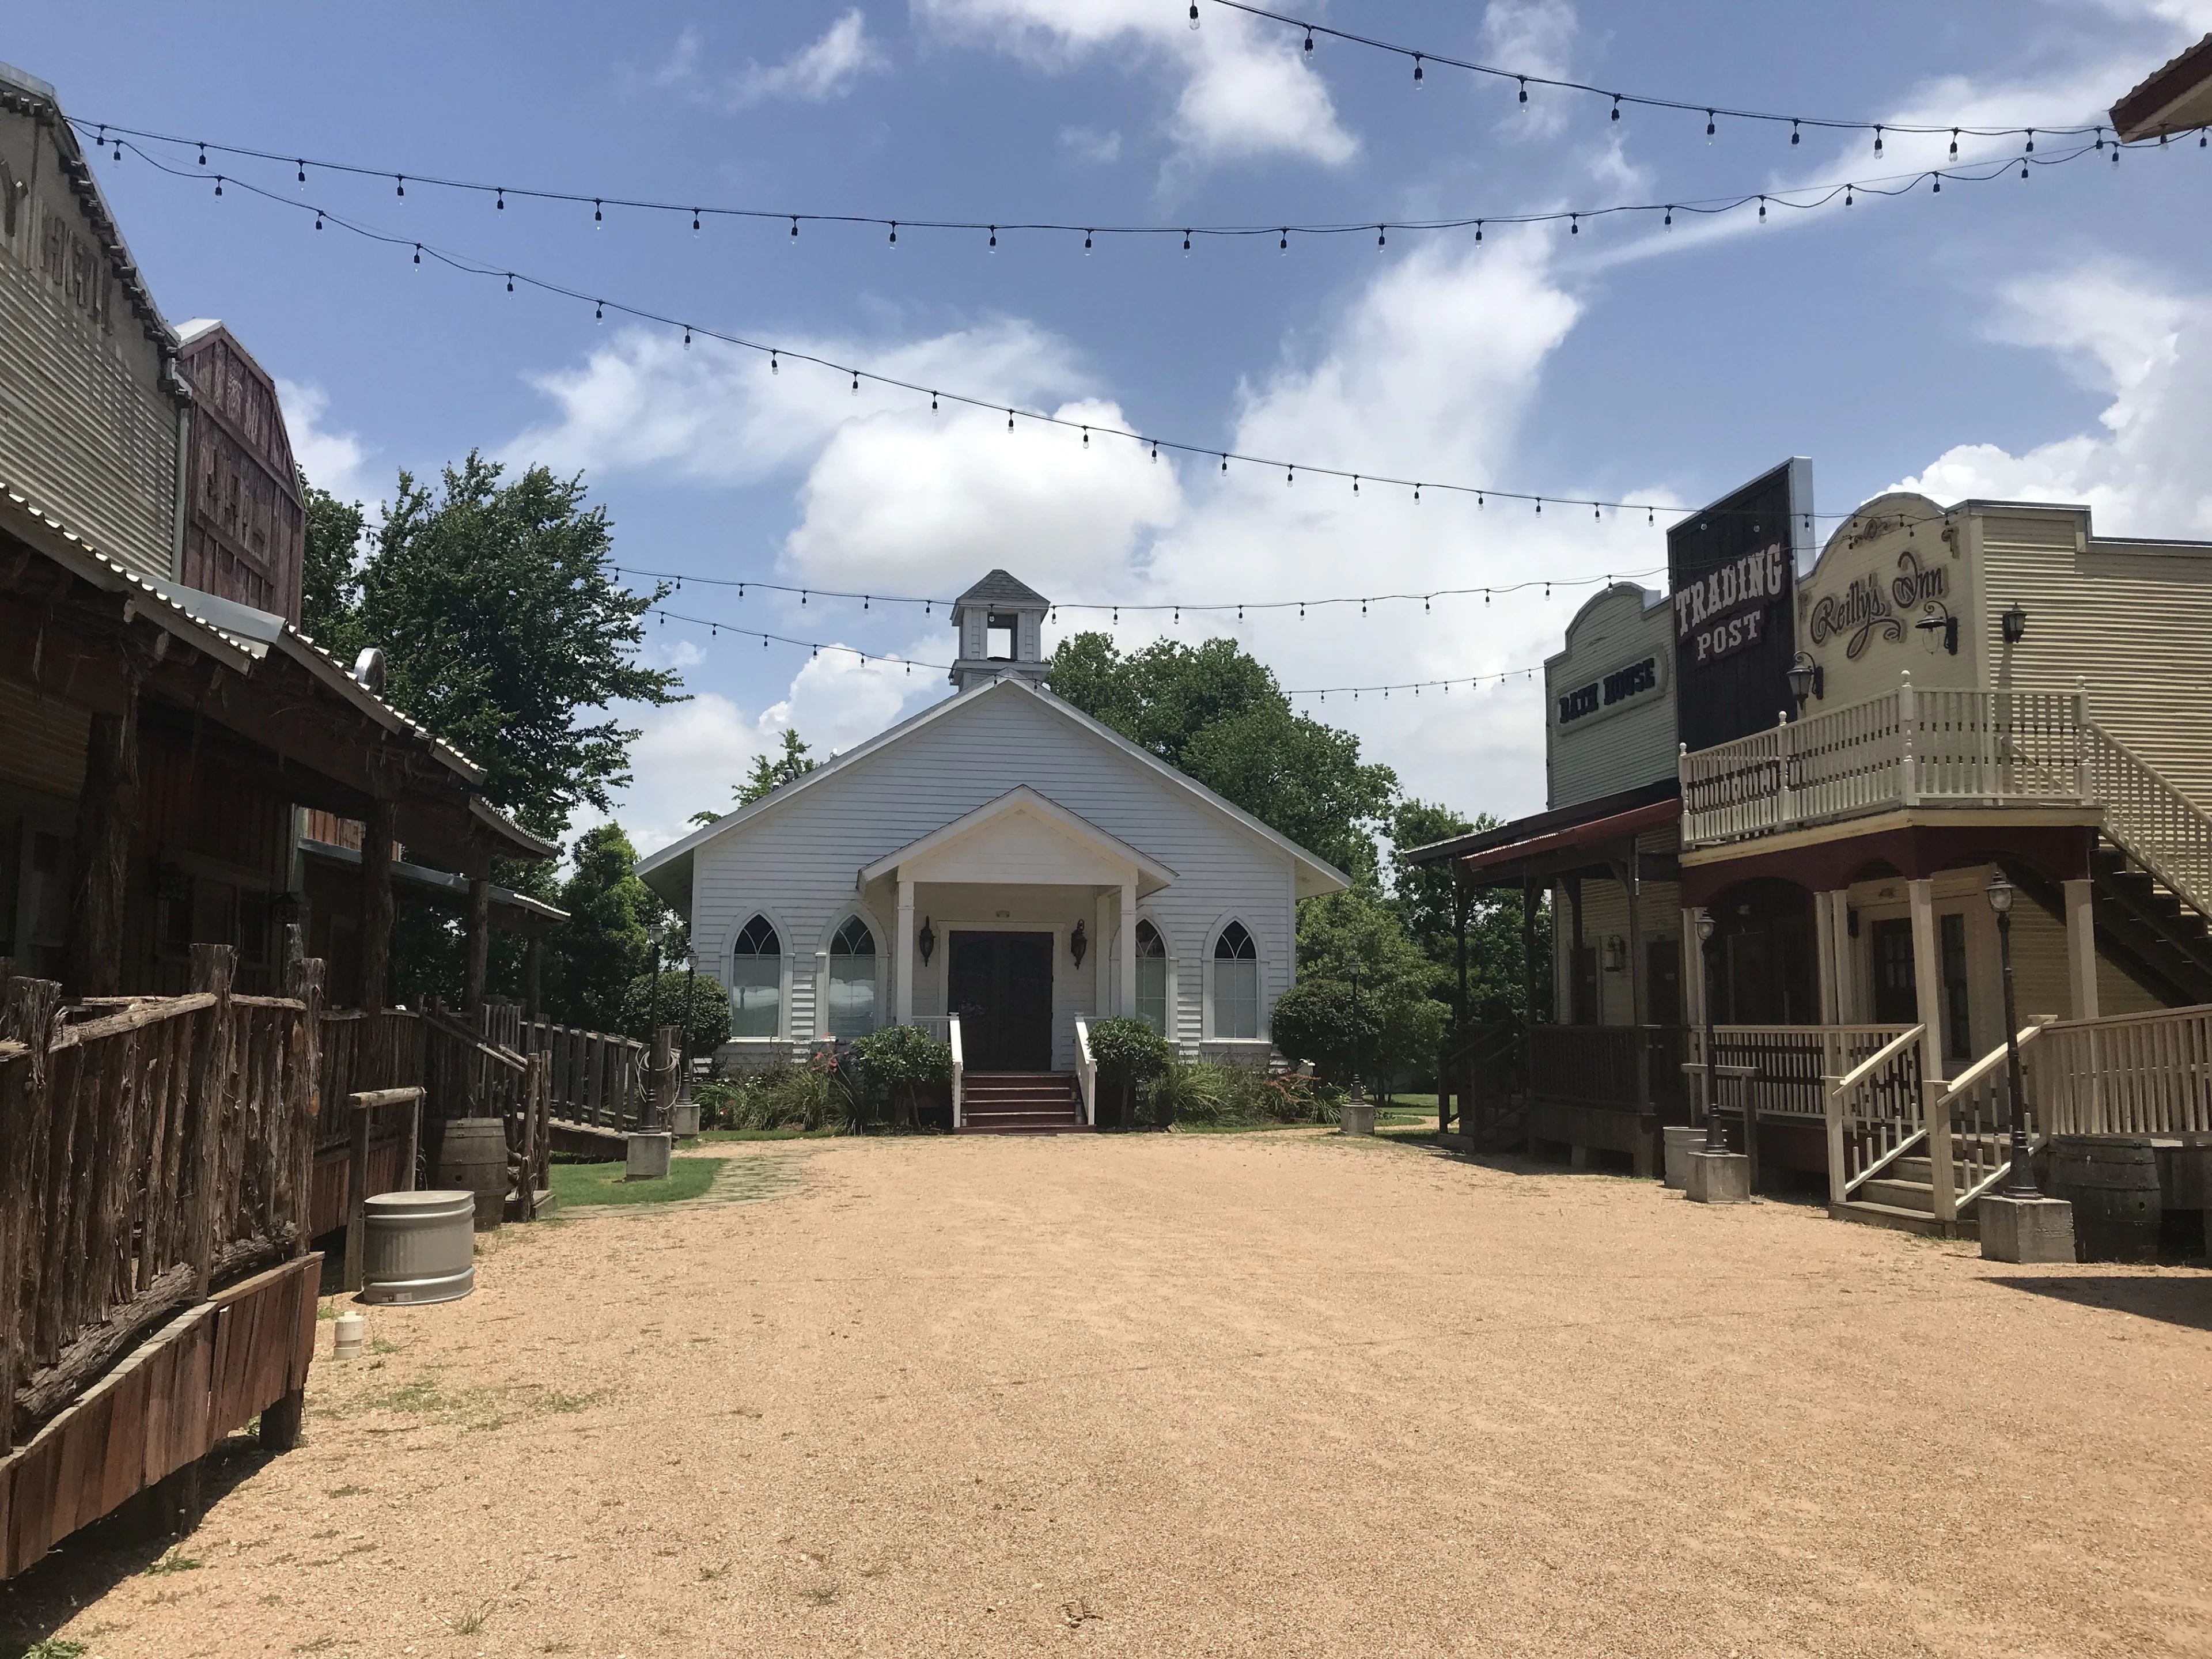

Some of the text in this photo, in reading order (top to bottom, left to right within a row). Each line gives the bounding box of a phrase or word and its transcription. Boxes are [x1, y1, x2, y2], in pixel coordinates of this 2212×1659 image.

[1675, 542, 1783, 638] TRADING
[1810, 551, 1944, 660] Reilly's Inn
[1696, 610, 1761, 661] POST
[1559, 657, 1656, 724] BATH HOUSE
